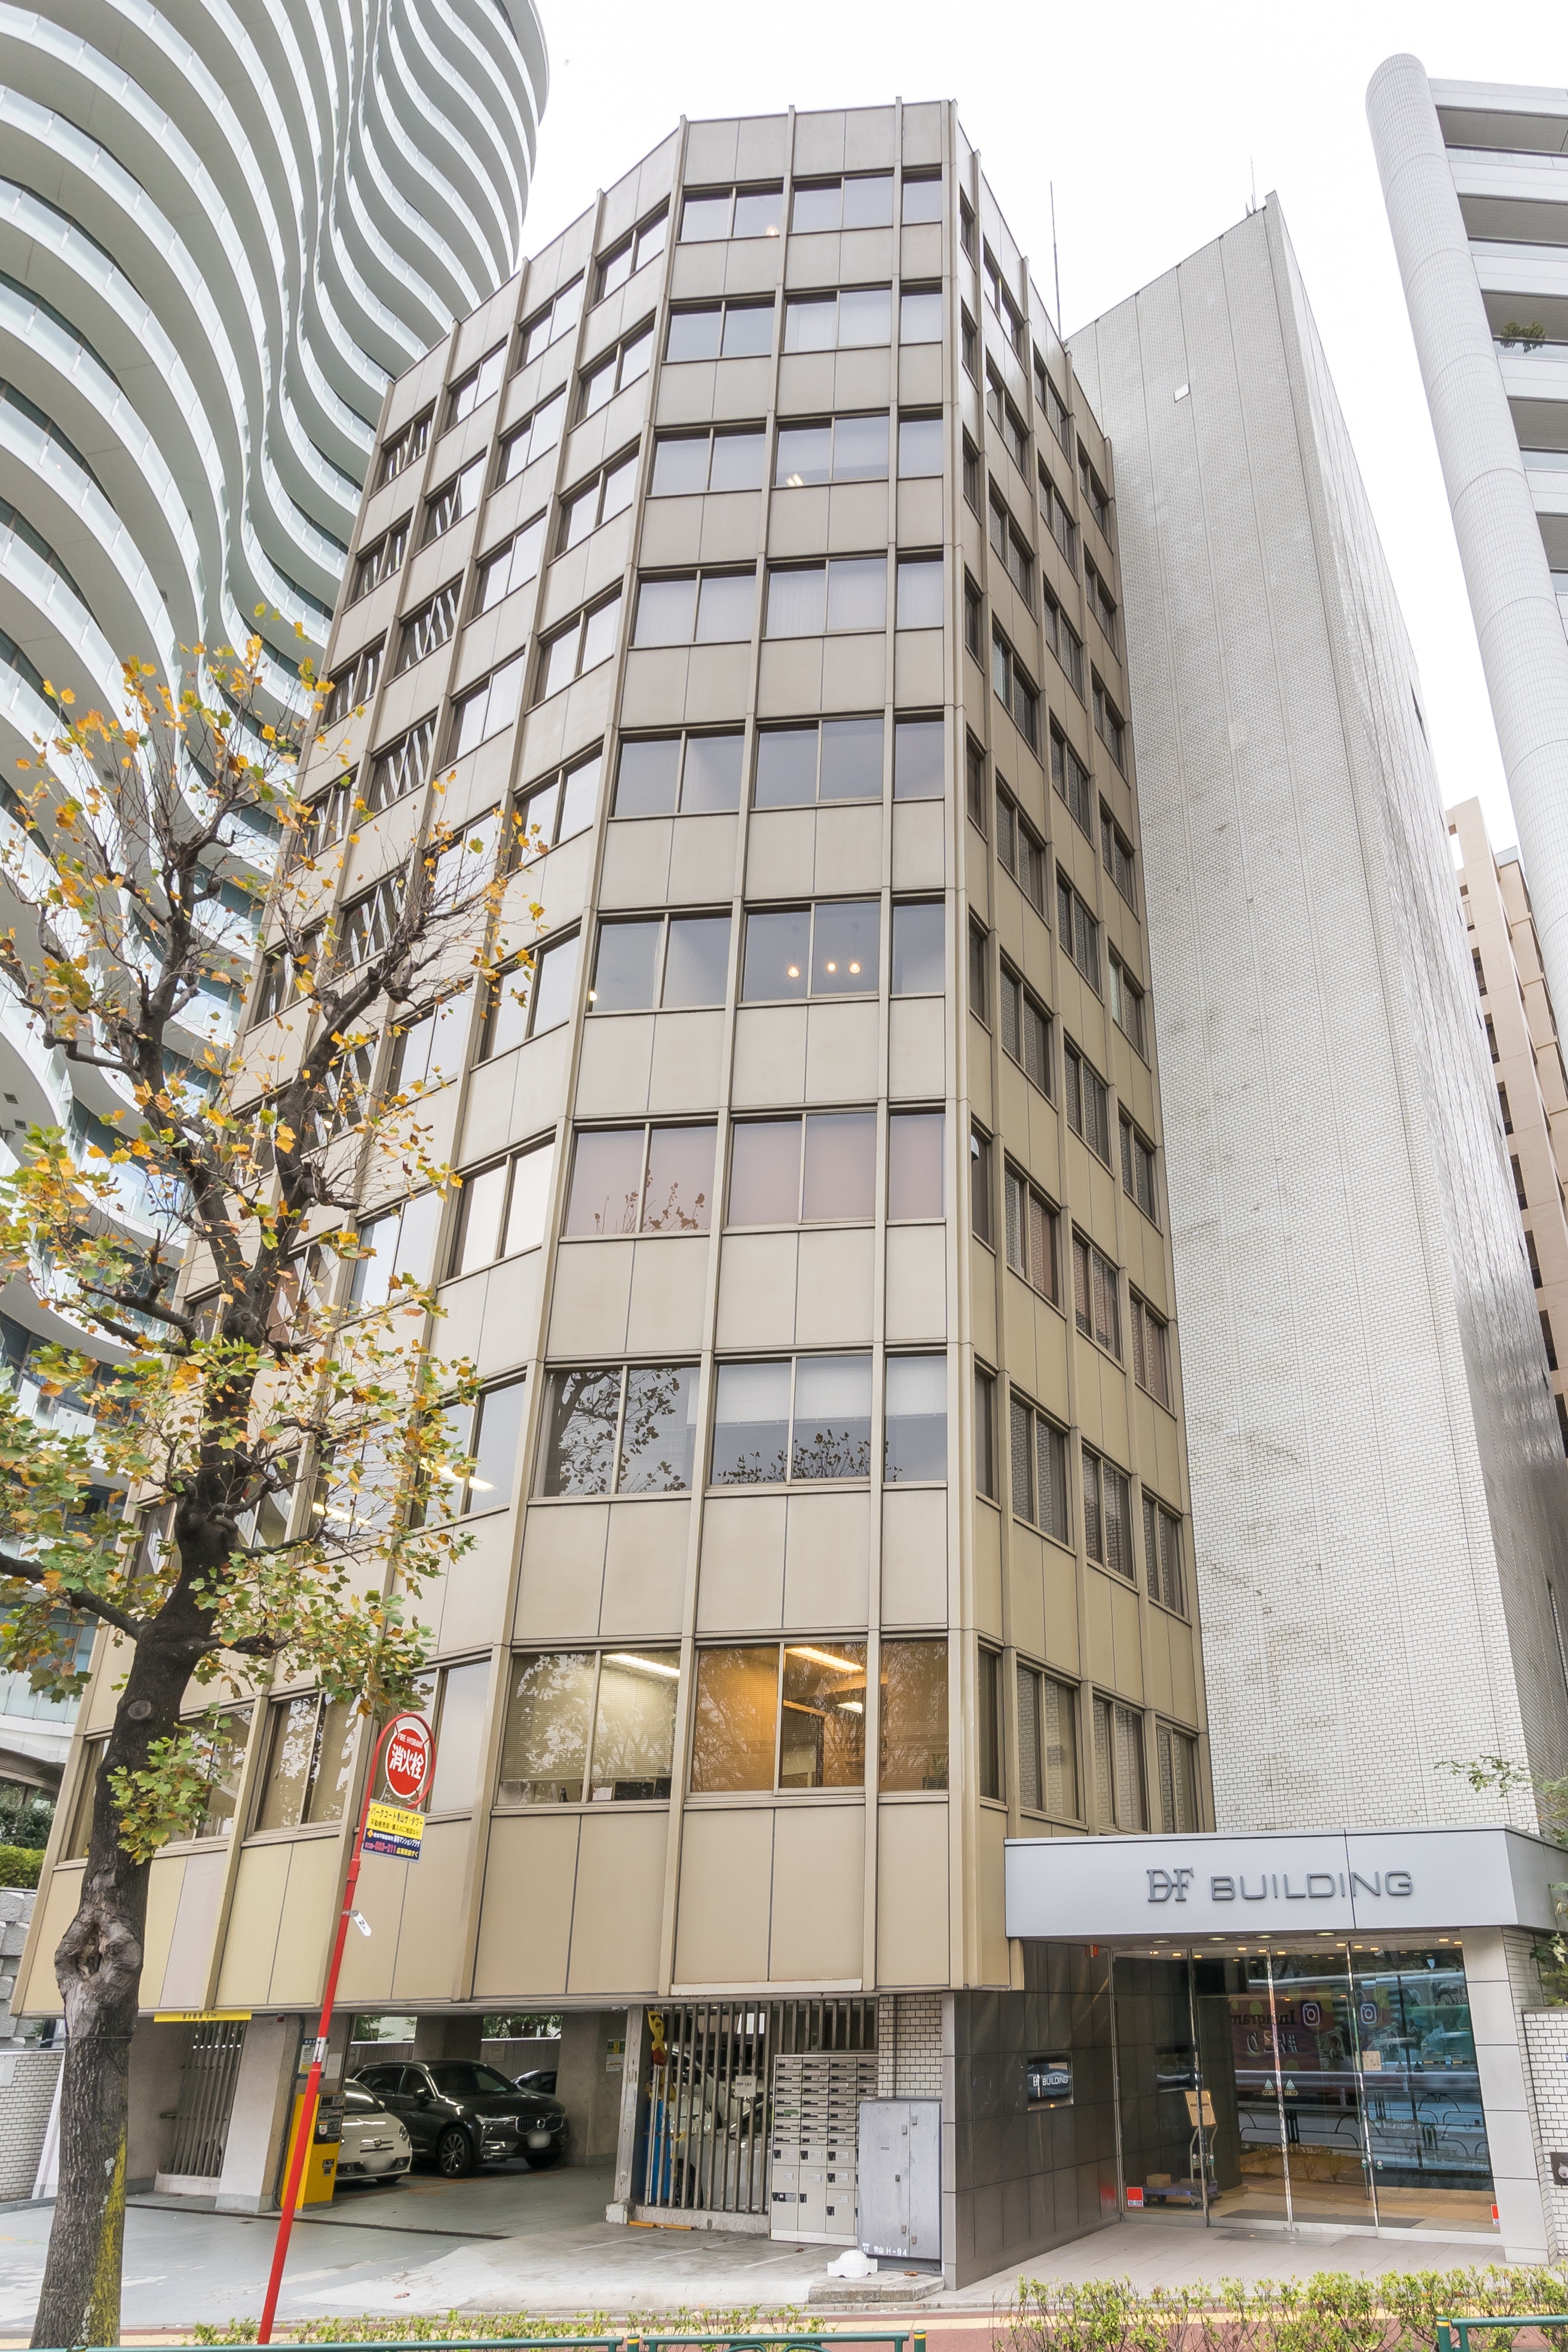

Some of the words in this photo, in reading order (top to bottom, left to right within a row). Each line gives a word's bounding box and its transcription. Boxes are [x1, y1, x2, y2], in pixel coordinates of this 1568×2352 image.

[397, 1732, 407, 1742] FIRE
[389, 1744, 424, 1780] 消火栓
[1146, 1867, 1194, 1902] DF
[1210, 1870, 1413, 1900] BUILDING
[1042, 2076, 1068, 2085] BUILDING
